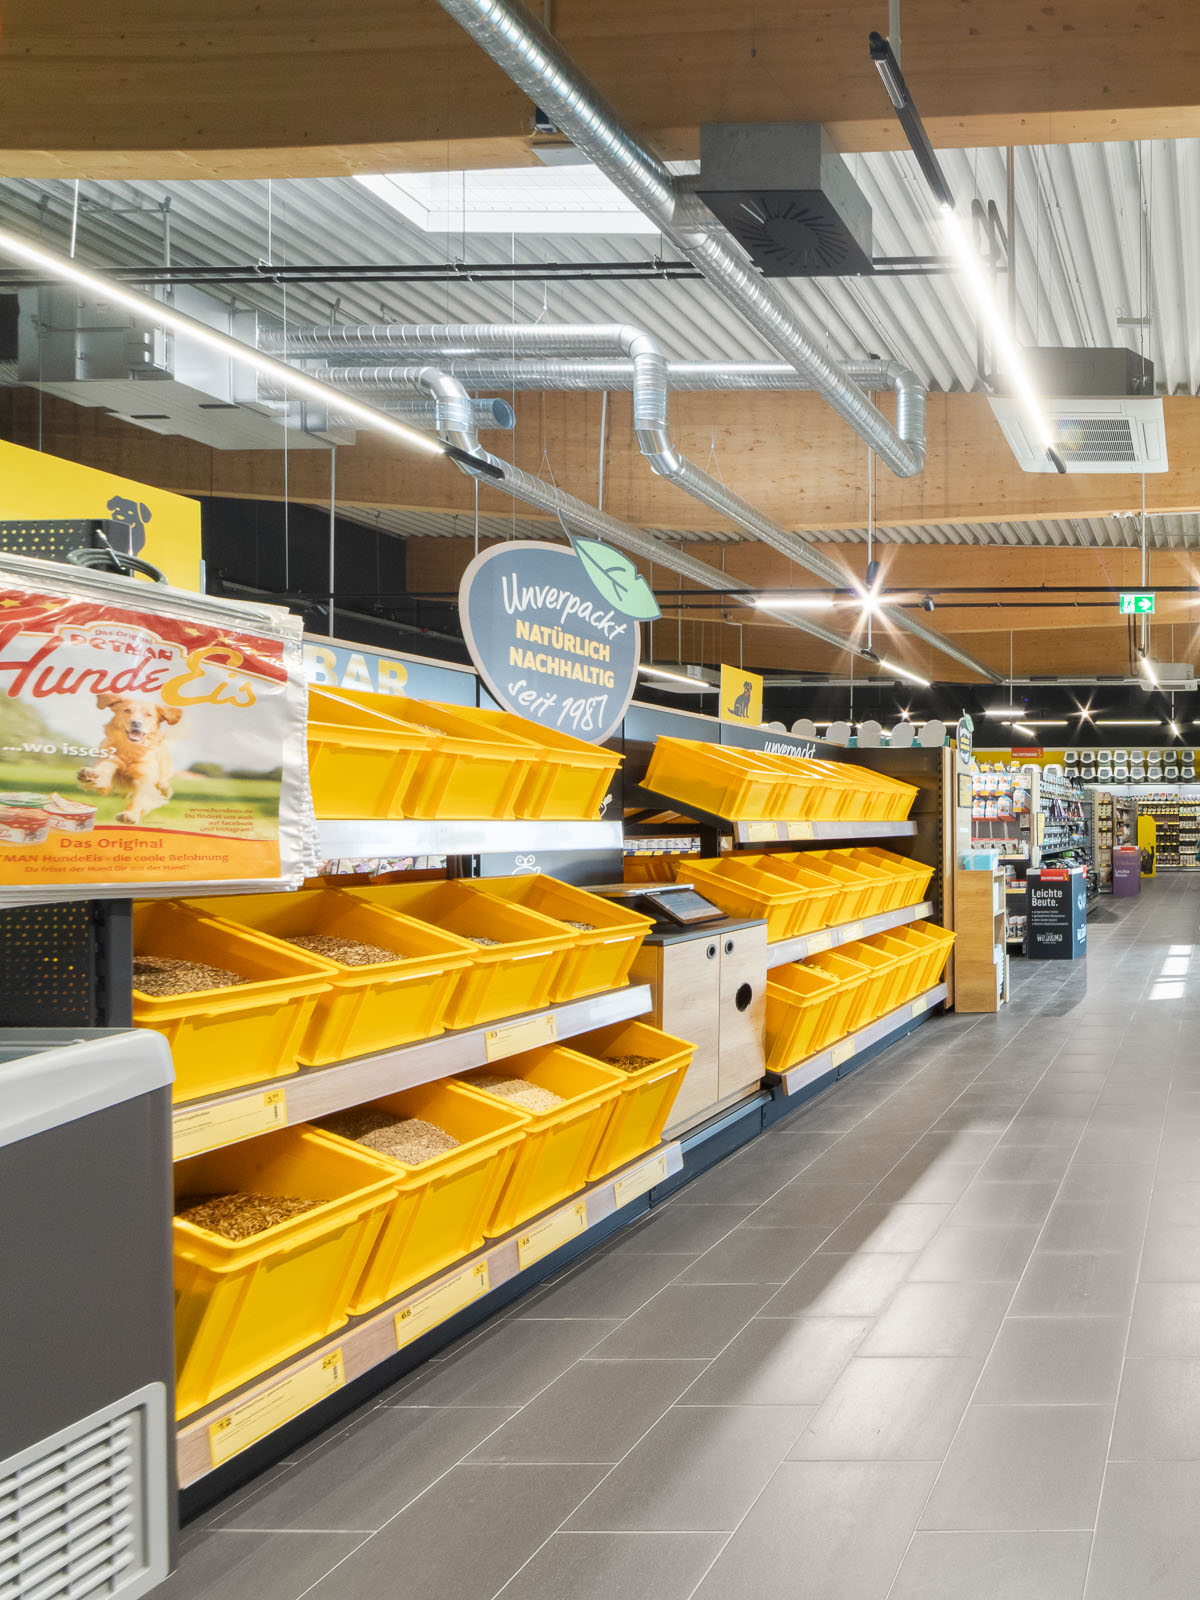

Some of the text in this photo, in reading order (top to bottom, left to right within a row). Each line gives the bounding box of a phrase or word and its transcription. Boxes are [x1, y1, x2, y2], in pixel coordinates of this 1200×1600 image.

[501, 572, 627, 640] Unverpackt
[515, 619, 611, 663] NATÜRLICH
[509, 647, 615, 689] NACHHALTIG
[161, 646, 256, 708] Eis
[508, 679, 609, 731] seit 1987
[63, 742, 117, 758] isses?
[60, 838, 163, 852] Das Original
[42, 853, 103, 863] HundeEis
[113, 853, 131, 862] die
[169, 853, 229, 864] Belohnung
[1031, 888, 1063, 898] Leichte
[1031, 897, 1059, 907] Beute.
[401, 1309, 412, 1320] 65
